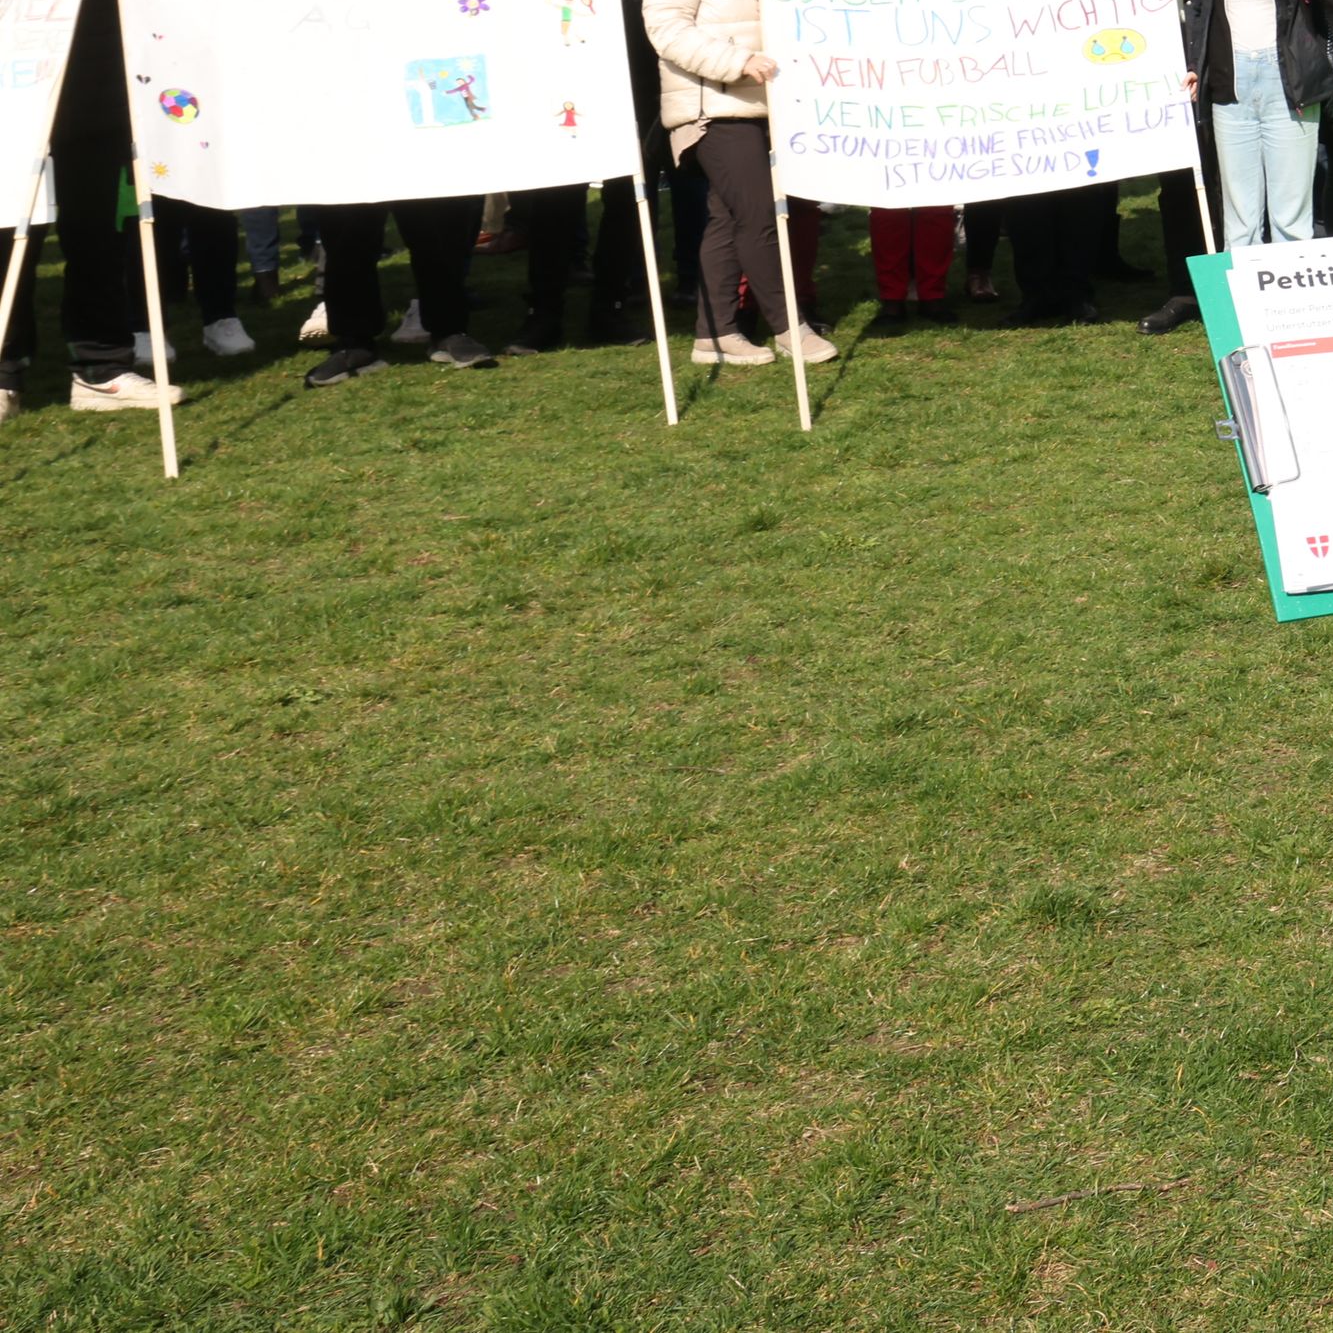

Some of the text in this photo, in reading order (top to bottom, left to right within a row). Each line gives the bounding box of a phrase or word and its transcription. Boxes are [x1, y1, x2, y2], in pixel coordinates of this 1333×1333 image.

[795, 6, 871, 45] IST
[895, 5, 992, 47] UNS
[789, 101, 1192, 160] 6 STUNDEN OHNE FRISCHE LUFT
[936, 101, 1074, 129] FRISCHE
[884, 160, 925, 192] IST
